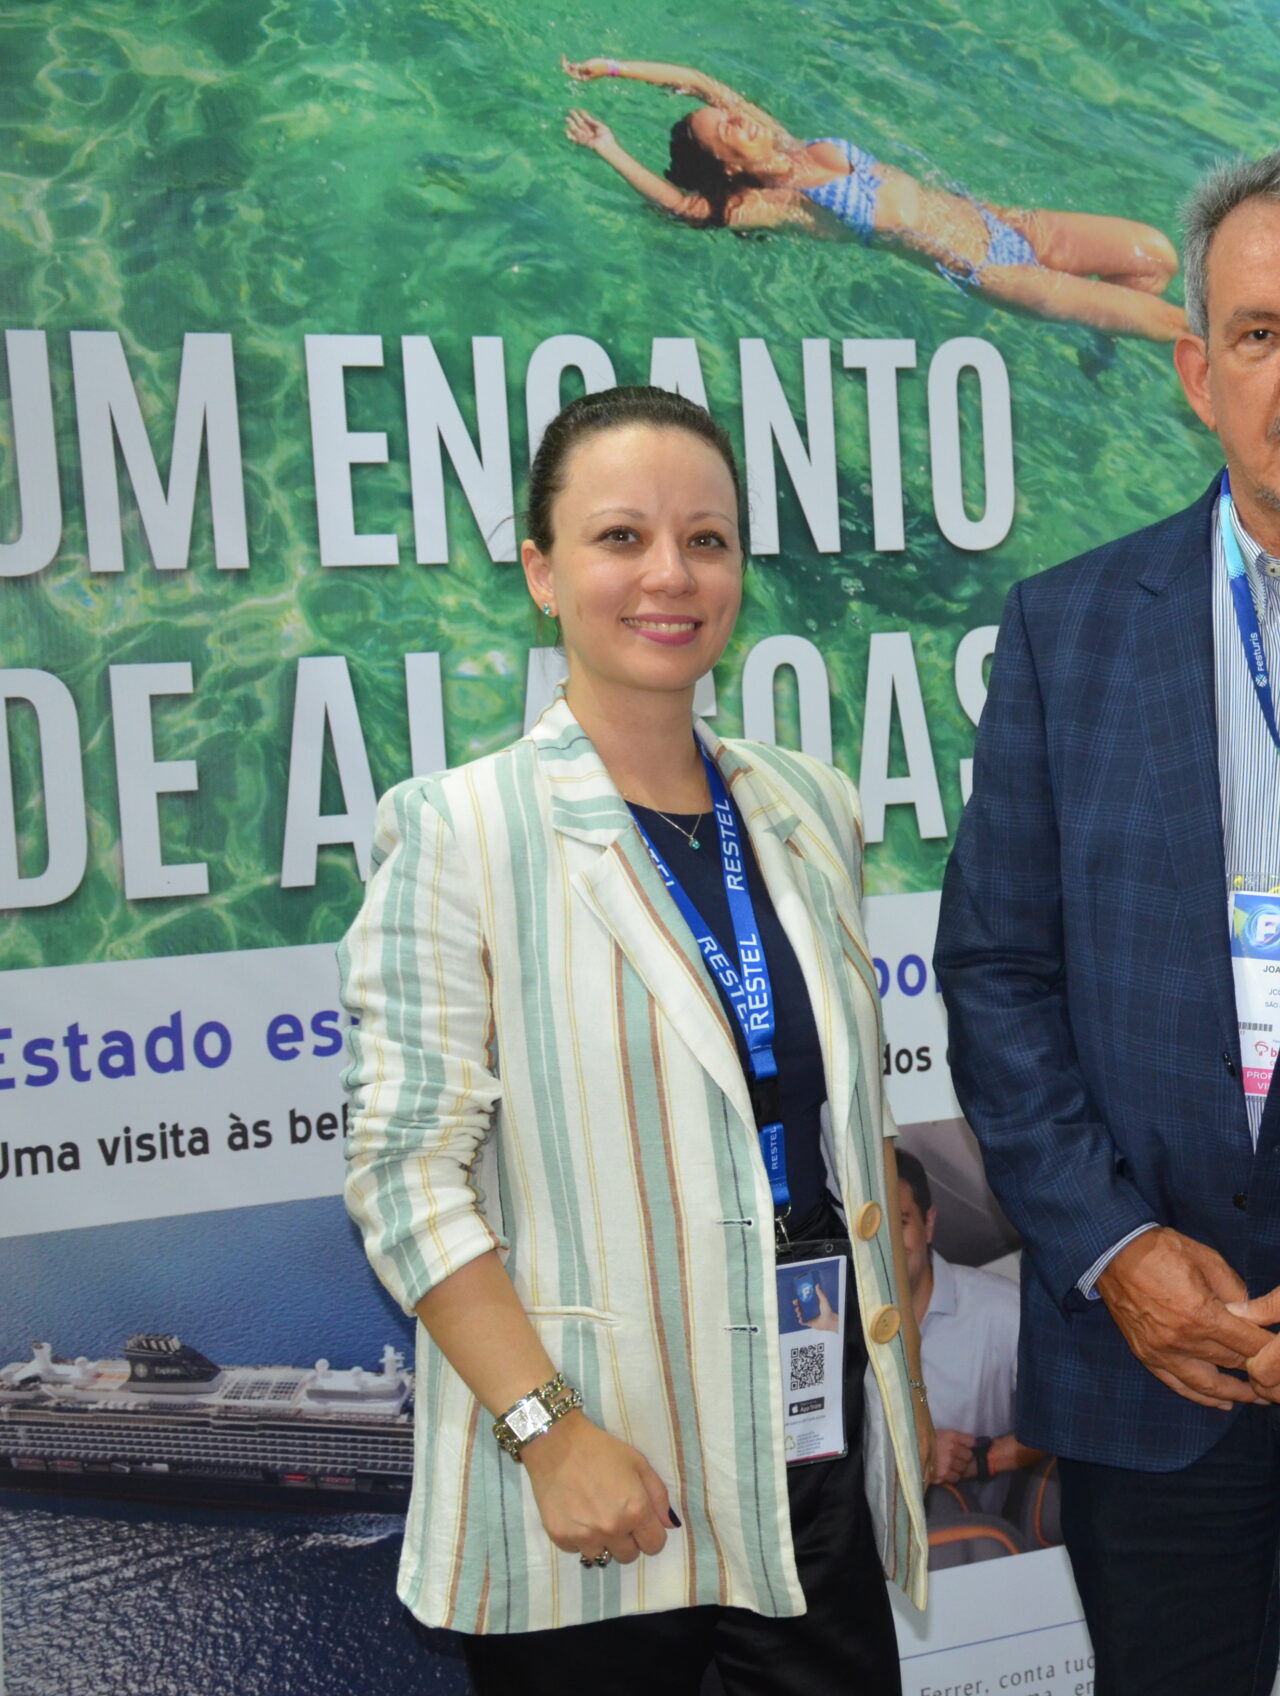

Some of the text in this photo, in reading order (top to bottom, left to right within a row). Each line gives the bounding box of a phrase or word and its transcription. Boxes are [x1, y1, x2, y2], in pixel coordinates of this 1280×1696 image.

[0, 330, 1016, 577] UM ENNTO
[1250, 632, 1265, 672] Festuris
[0, 661, 209, 910] DE
[713, 798, 745, 892] RESTEL
[697, 935, 751, 1035] REST
[738, 932, 772, 1031] RESTEL
[266, 1010, 359, 1062] es
[1246, 1070, 1273, 1080] PROF
[98, 1122, 210, 1167] visita
[227, 1113, 272, 1152] às
[289, 1103, 349, 1145] bel
[770, 1126, 778, 1171] RESTEL
[999, 1662, 1055, 1689] conta
